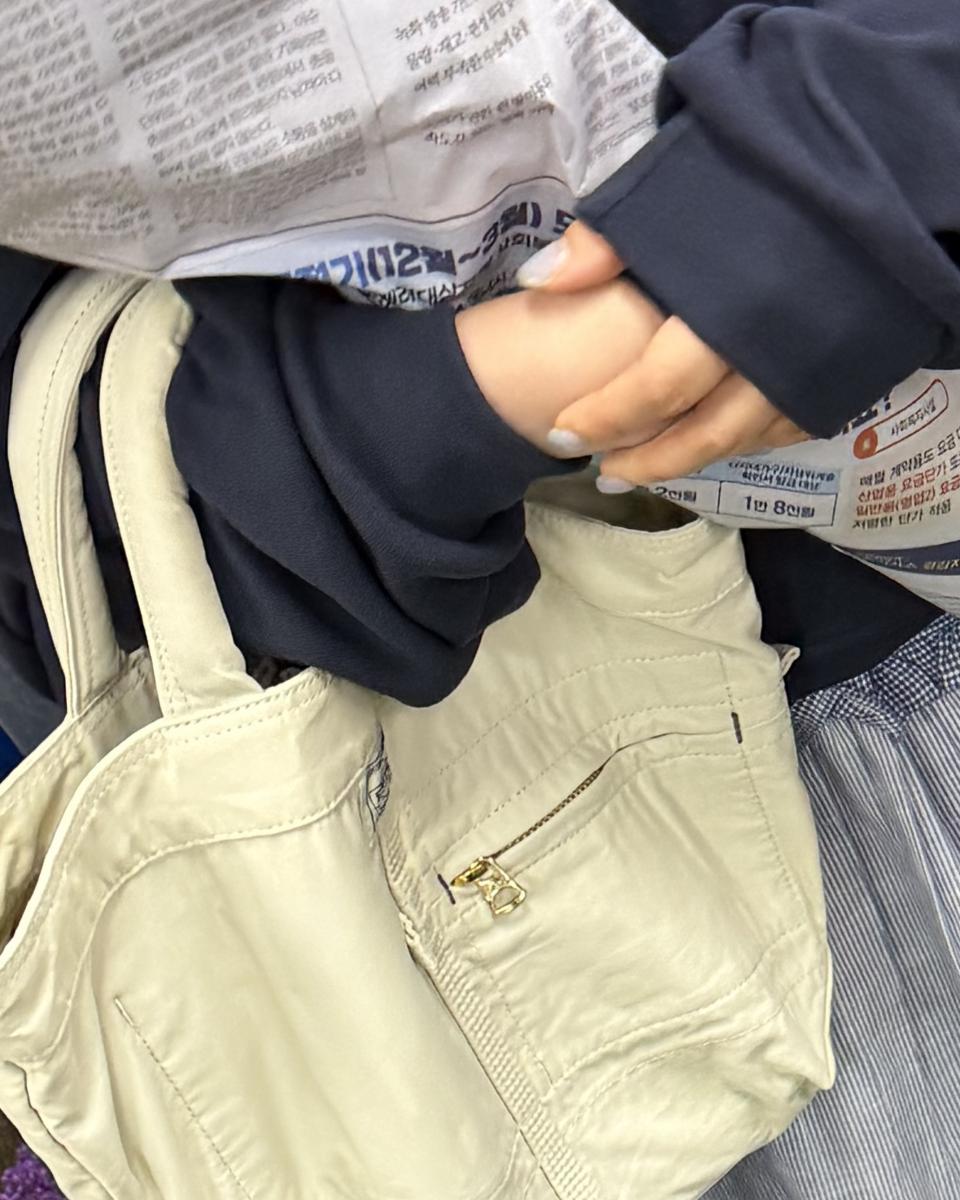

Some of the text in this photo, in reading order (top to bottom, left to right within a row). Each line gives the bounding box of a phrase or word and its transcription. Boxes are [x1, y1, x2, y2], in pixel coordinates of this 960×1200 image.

[937, 432, 956, 457] 요금
[858, 482, 897, 503] 산업용
[900, 460, 947, 493] 요금단가
[744, 496, 768, 513] 1만
[852, 515, 893, 530] 저렴한
[898, 507, 924, 525] 단가
